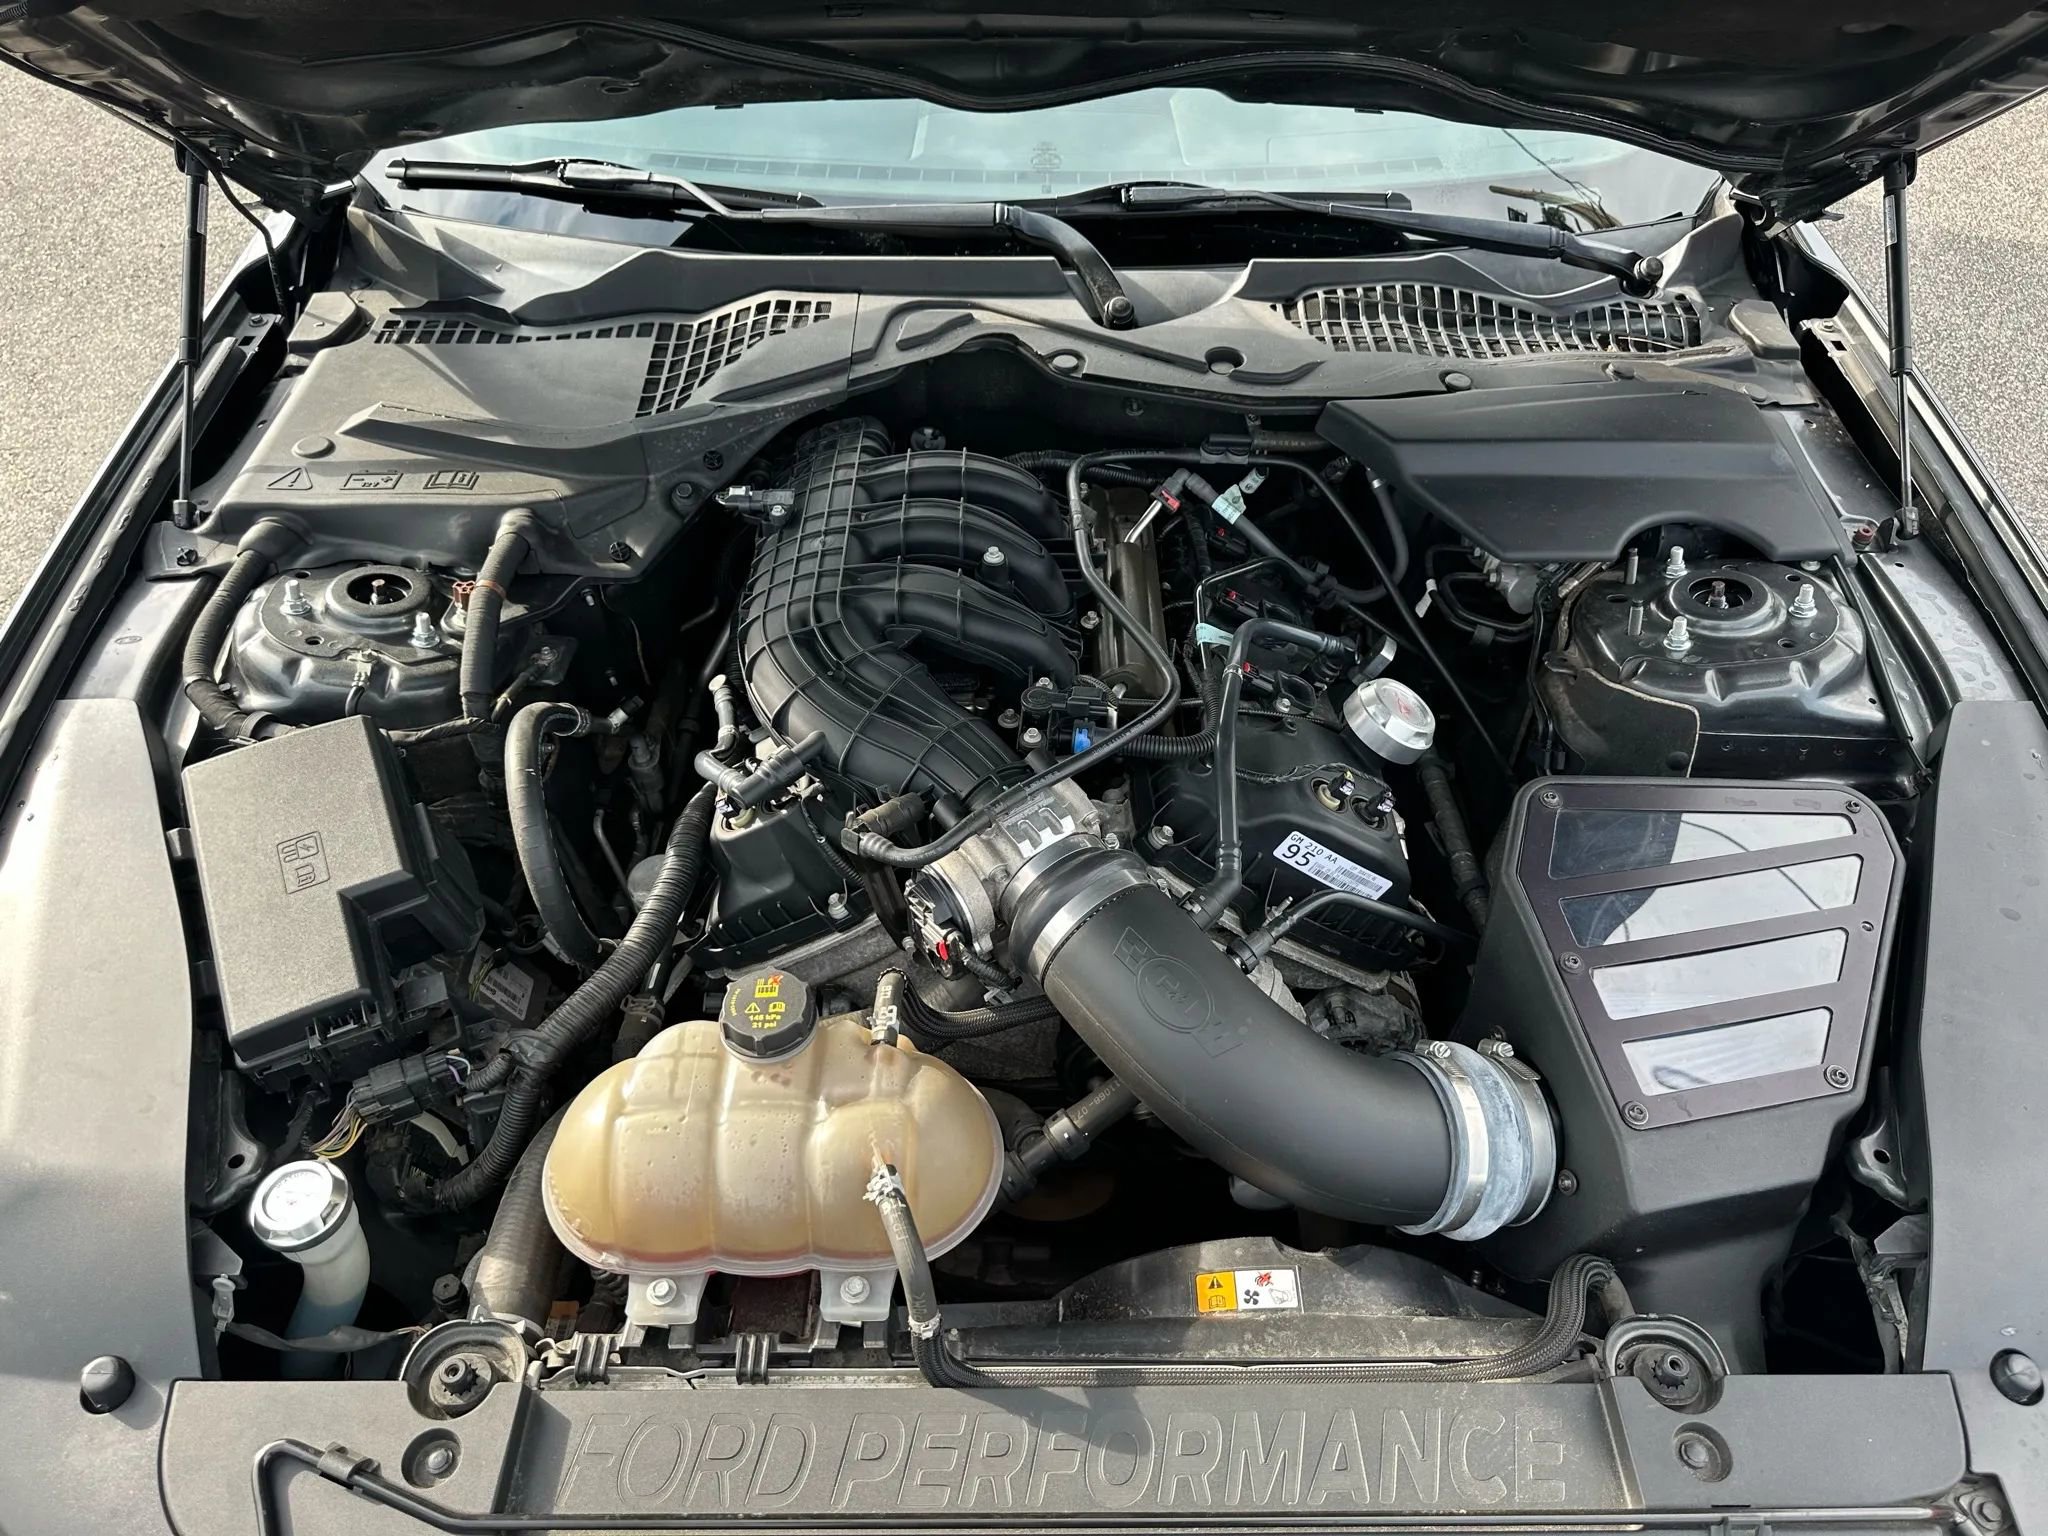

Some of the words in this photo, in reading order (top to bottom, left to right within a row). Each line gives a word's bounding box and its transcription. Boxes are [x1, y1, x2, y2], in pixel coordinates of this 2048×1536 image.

[1281, 844, 1316, 866] 95
[1304, 841, 1324, 856] 210
[1324, 853, 1339, 865] AA
[556, 1411, 817, 1508] FORD
[830, 1406, 1567, 1508] PERFORMANCE
